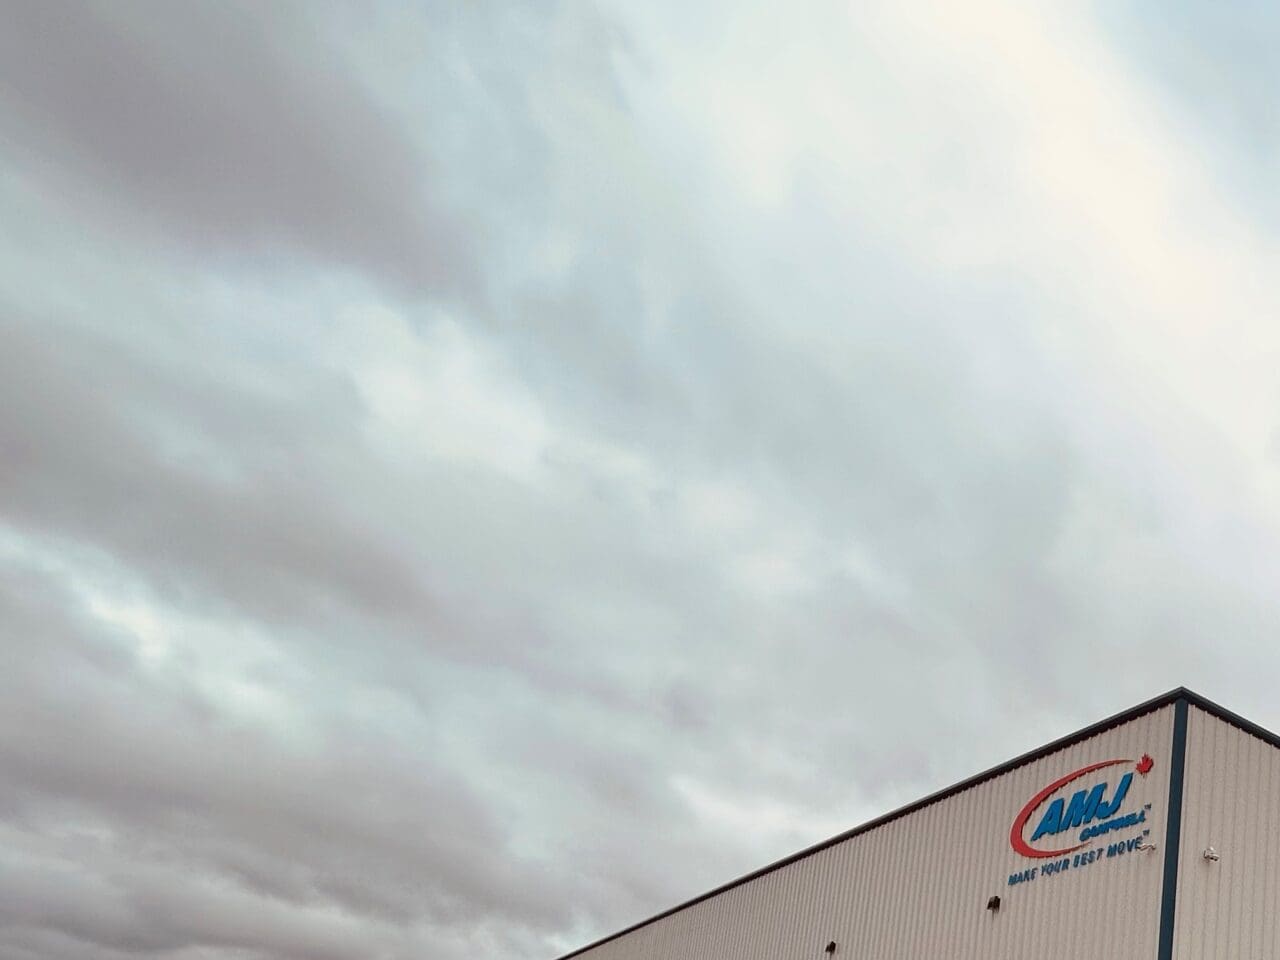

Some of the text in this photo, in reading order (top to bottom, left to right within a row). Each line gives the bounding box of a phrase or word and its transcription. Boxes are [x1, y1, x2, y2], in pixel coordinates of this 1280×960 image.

[1031, 772, 1134, 842] AMJ
[1008, 867, 1038, 886] MAKE
[1040, 859, 1070, 876] YOUR
[1072, 848, 1103, 868] BEST
[1106, 836, 1144, 858] MOVE
